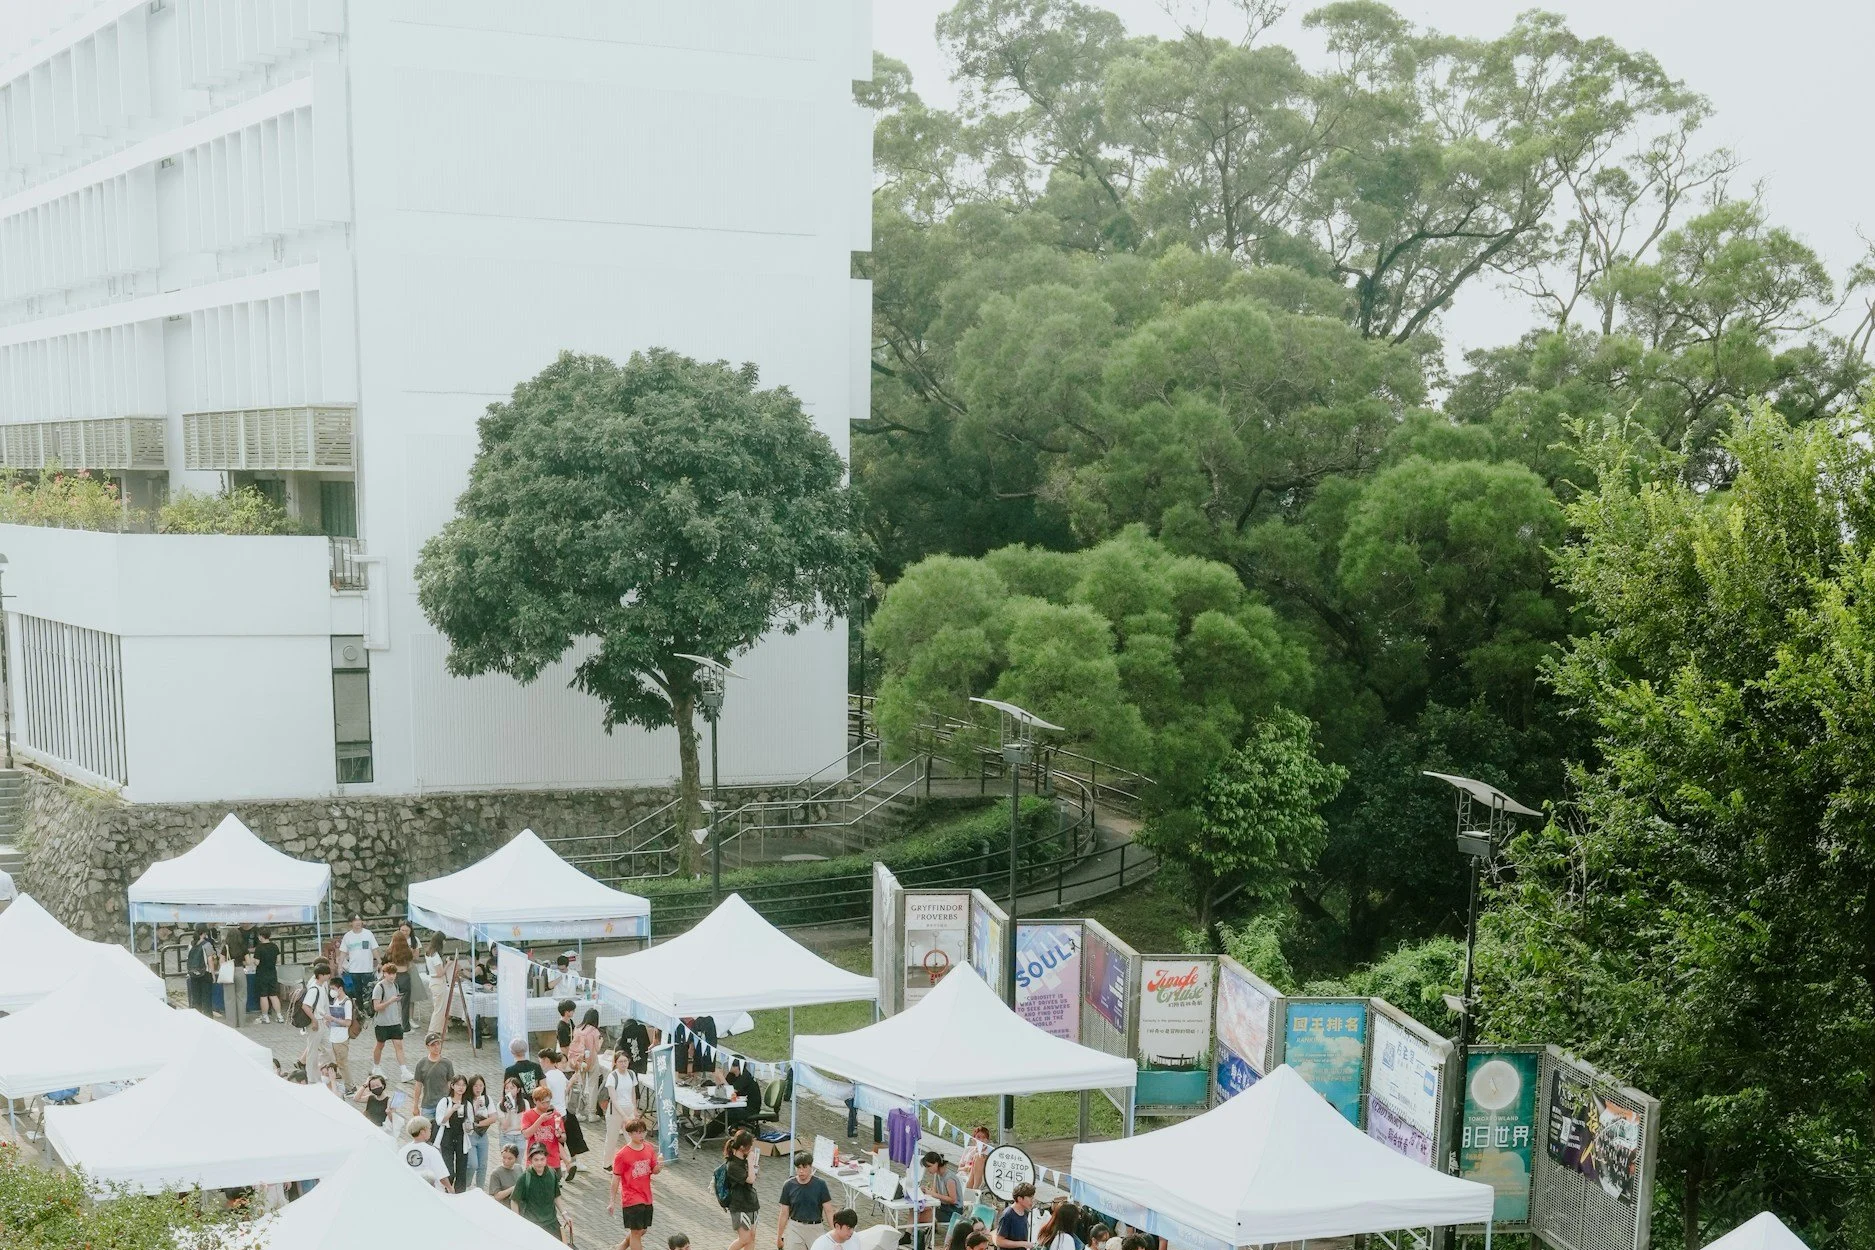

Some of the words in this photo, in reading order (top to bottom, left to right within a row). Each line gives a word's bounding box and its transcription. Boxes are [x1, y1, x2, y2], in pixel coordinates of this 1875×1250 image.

[1147, 966, 1198, 992] Jungle
[1157, 985, 1204, 1003] Cruise
[993, 1160, 1007, 1168] BUS
[1011, 1163, 1029, 1171] STOP
[995, 1181, 1002, 1189] 6
